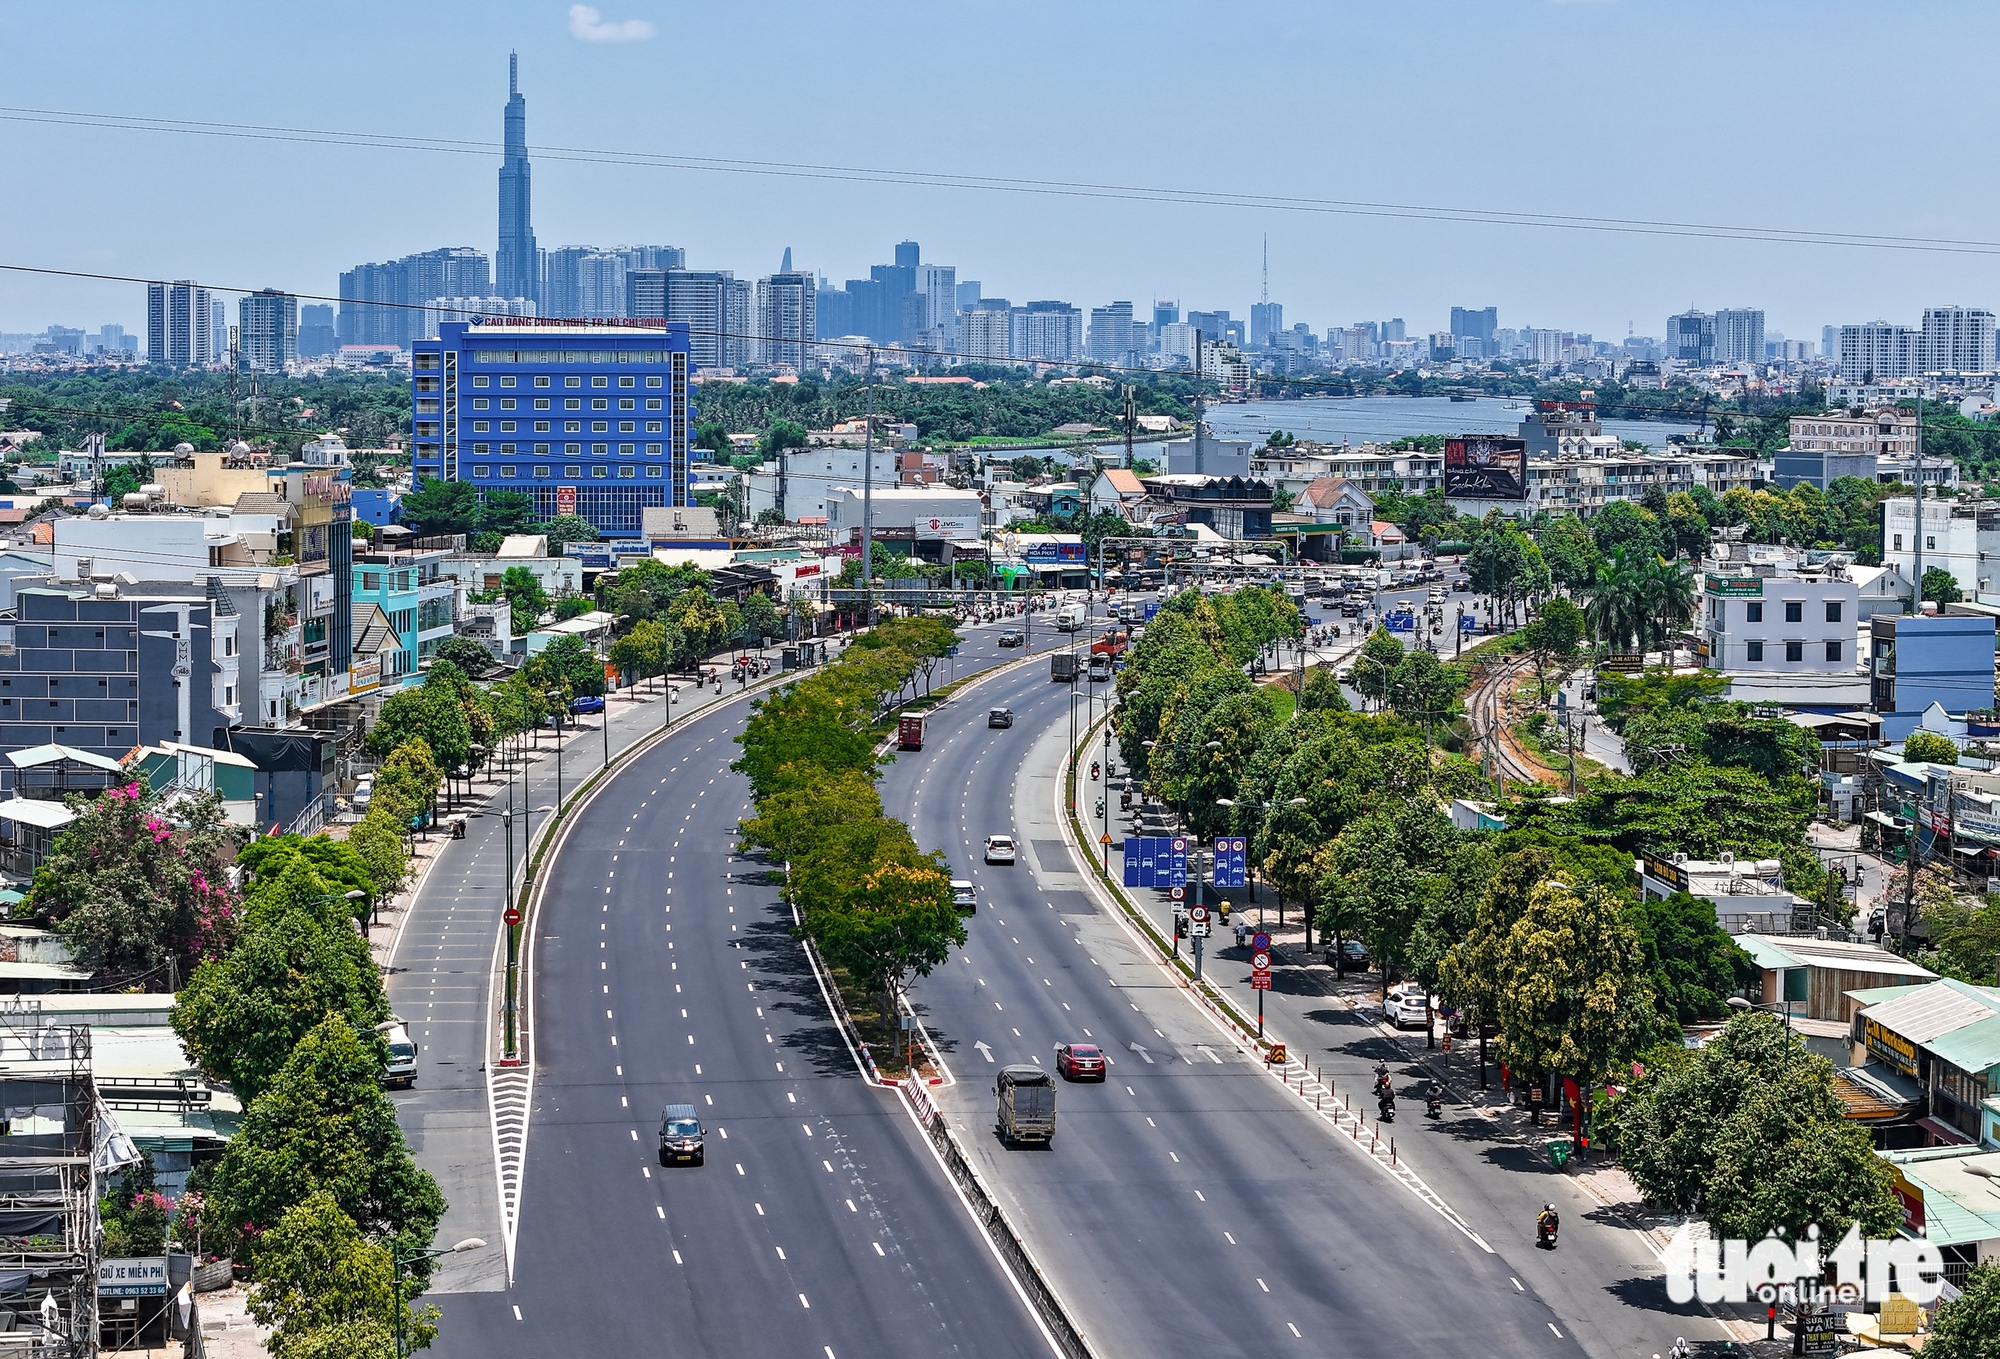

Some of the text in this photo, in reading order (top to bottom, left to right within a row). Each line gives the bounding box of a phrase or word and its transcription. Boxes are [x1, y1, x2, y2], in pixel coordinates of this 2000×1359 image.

[484, 317, 503, 327] CAO
[641, 318, 667, 327] MINH
[1194, 909, 1203, 917] 60
[1881, 1025, 1914, 1062] Workshop
[100, 1262, 164, 1279] GIỮ XE MIỄN PHÍ
[1806, 1315, 1834, 1329] SỬA XE
[1806, 1333, 1819, 1341] THAY
